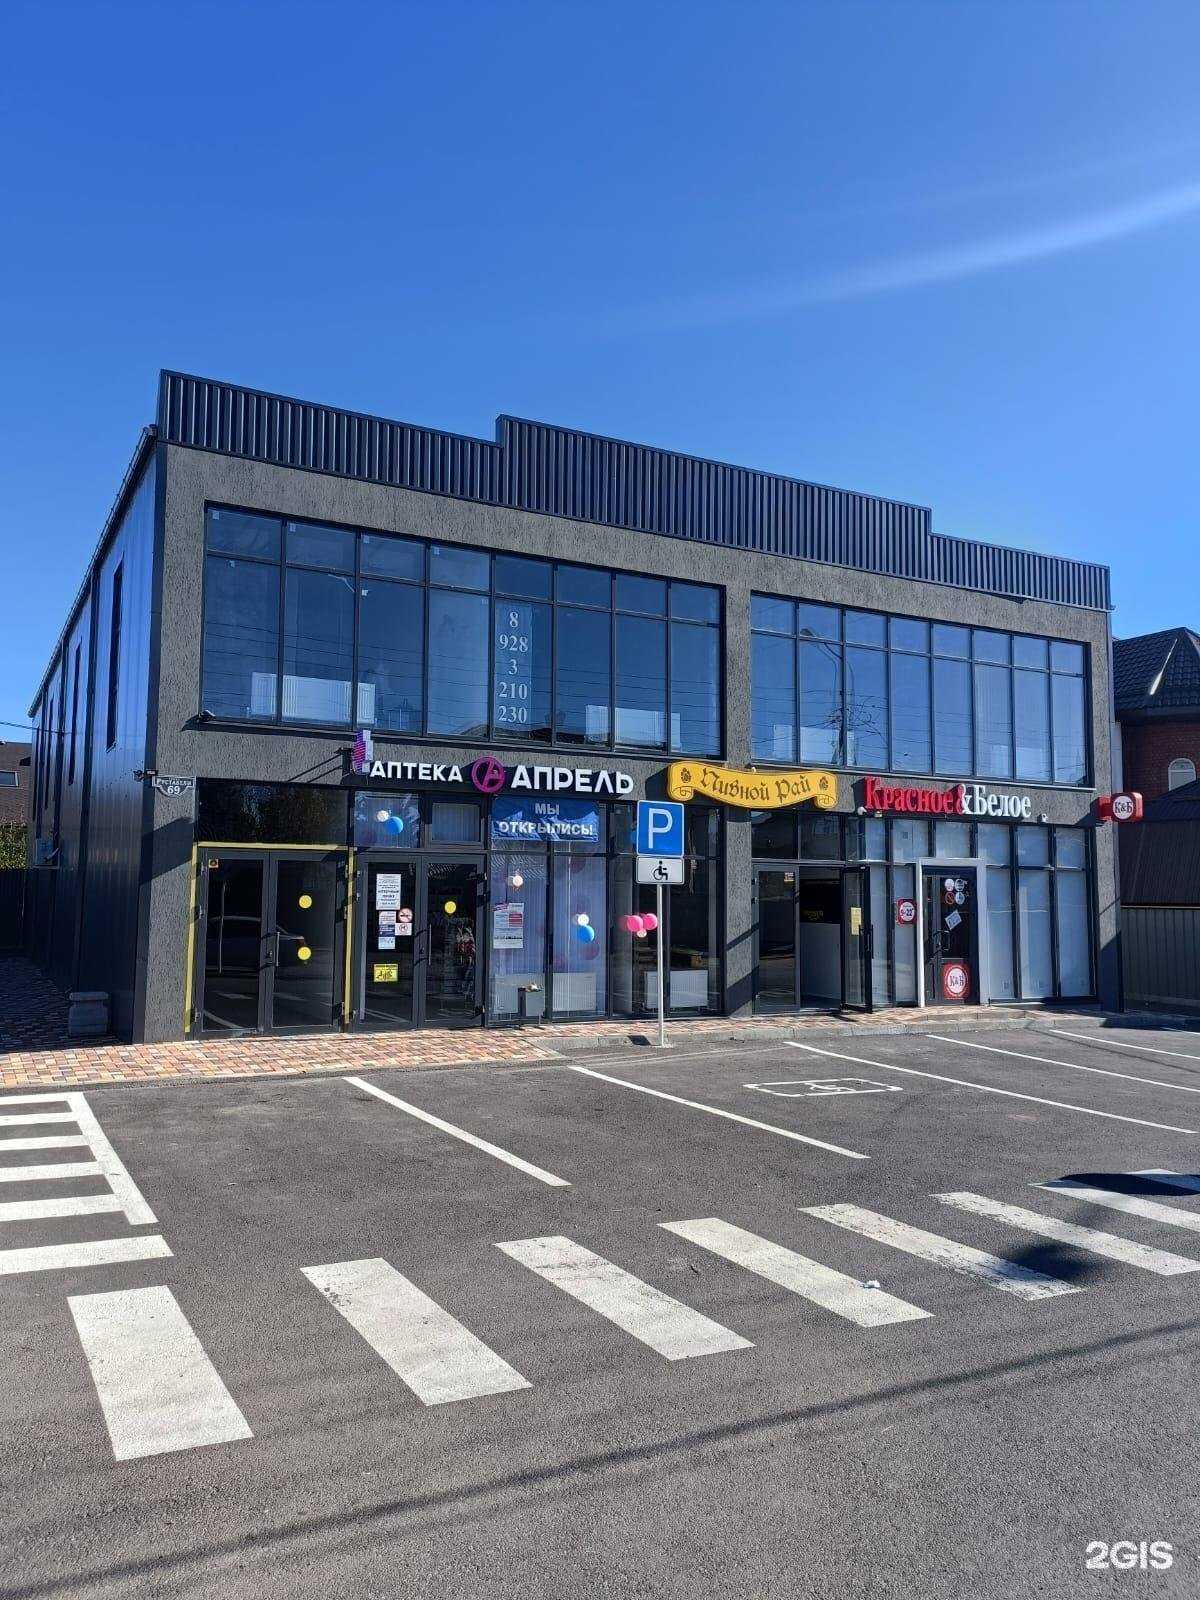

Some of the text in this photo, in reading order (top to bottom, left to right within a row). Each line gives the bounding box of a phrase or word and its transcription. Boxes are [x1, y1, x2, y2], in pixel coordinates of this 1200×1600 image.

[508, 610, 519, 628] 8
[499, 633, 529, 653] 928
[508, 659, 518, 675] 3
[498, 681, 528, 700] 210
[498, 705, 528, 724] 230
[369, 760, 464, 783] АПТЕКА
[511, 764, 634, 794] АПРЕЛЬ
[700, 767, 811, 804] Пивной Рай
[167, 785, 181, 795] 69
[535, 803, 560, 815] МЫ
[648, 807, 673, 849] P
